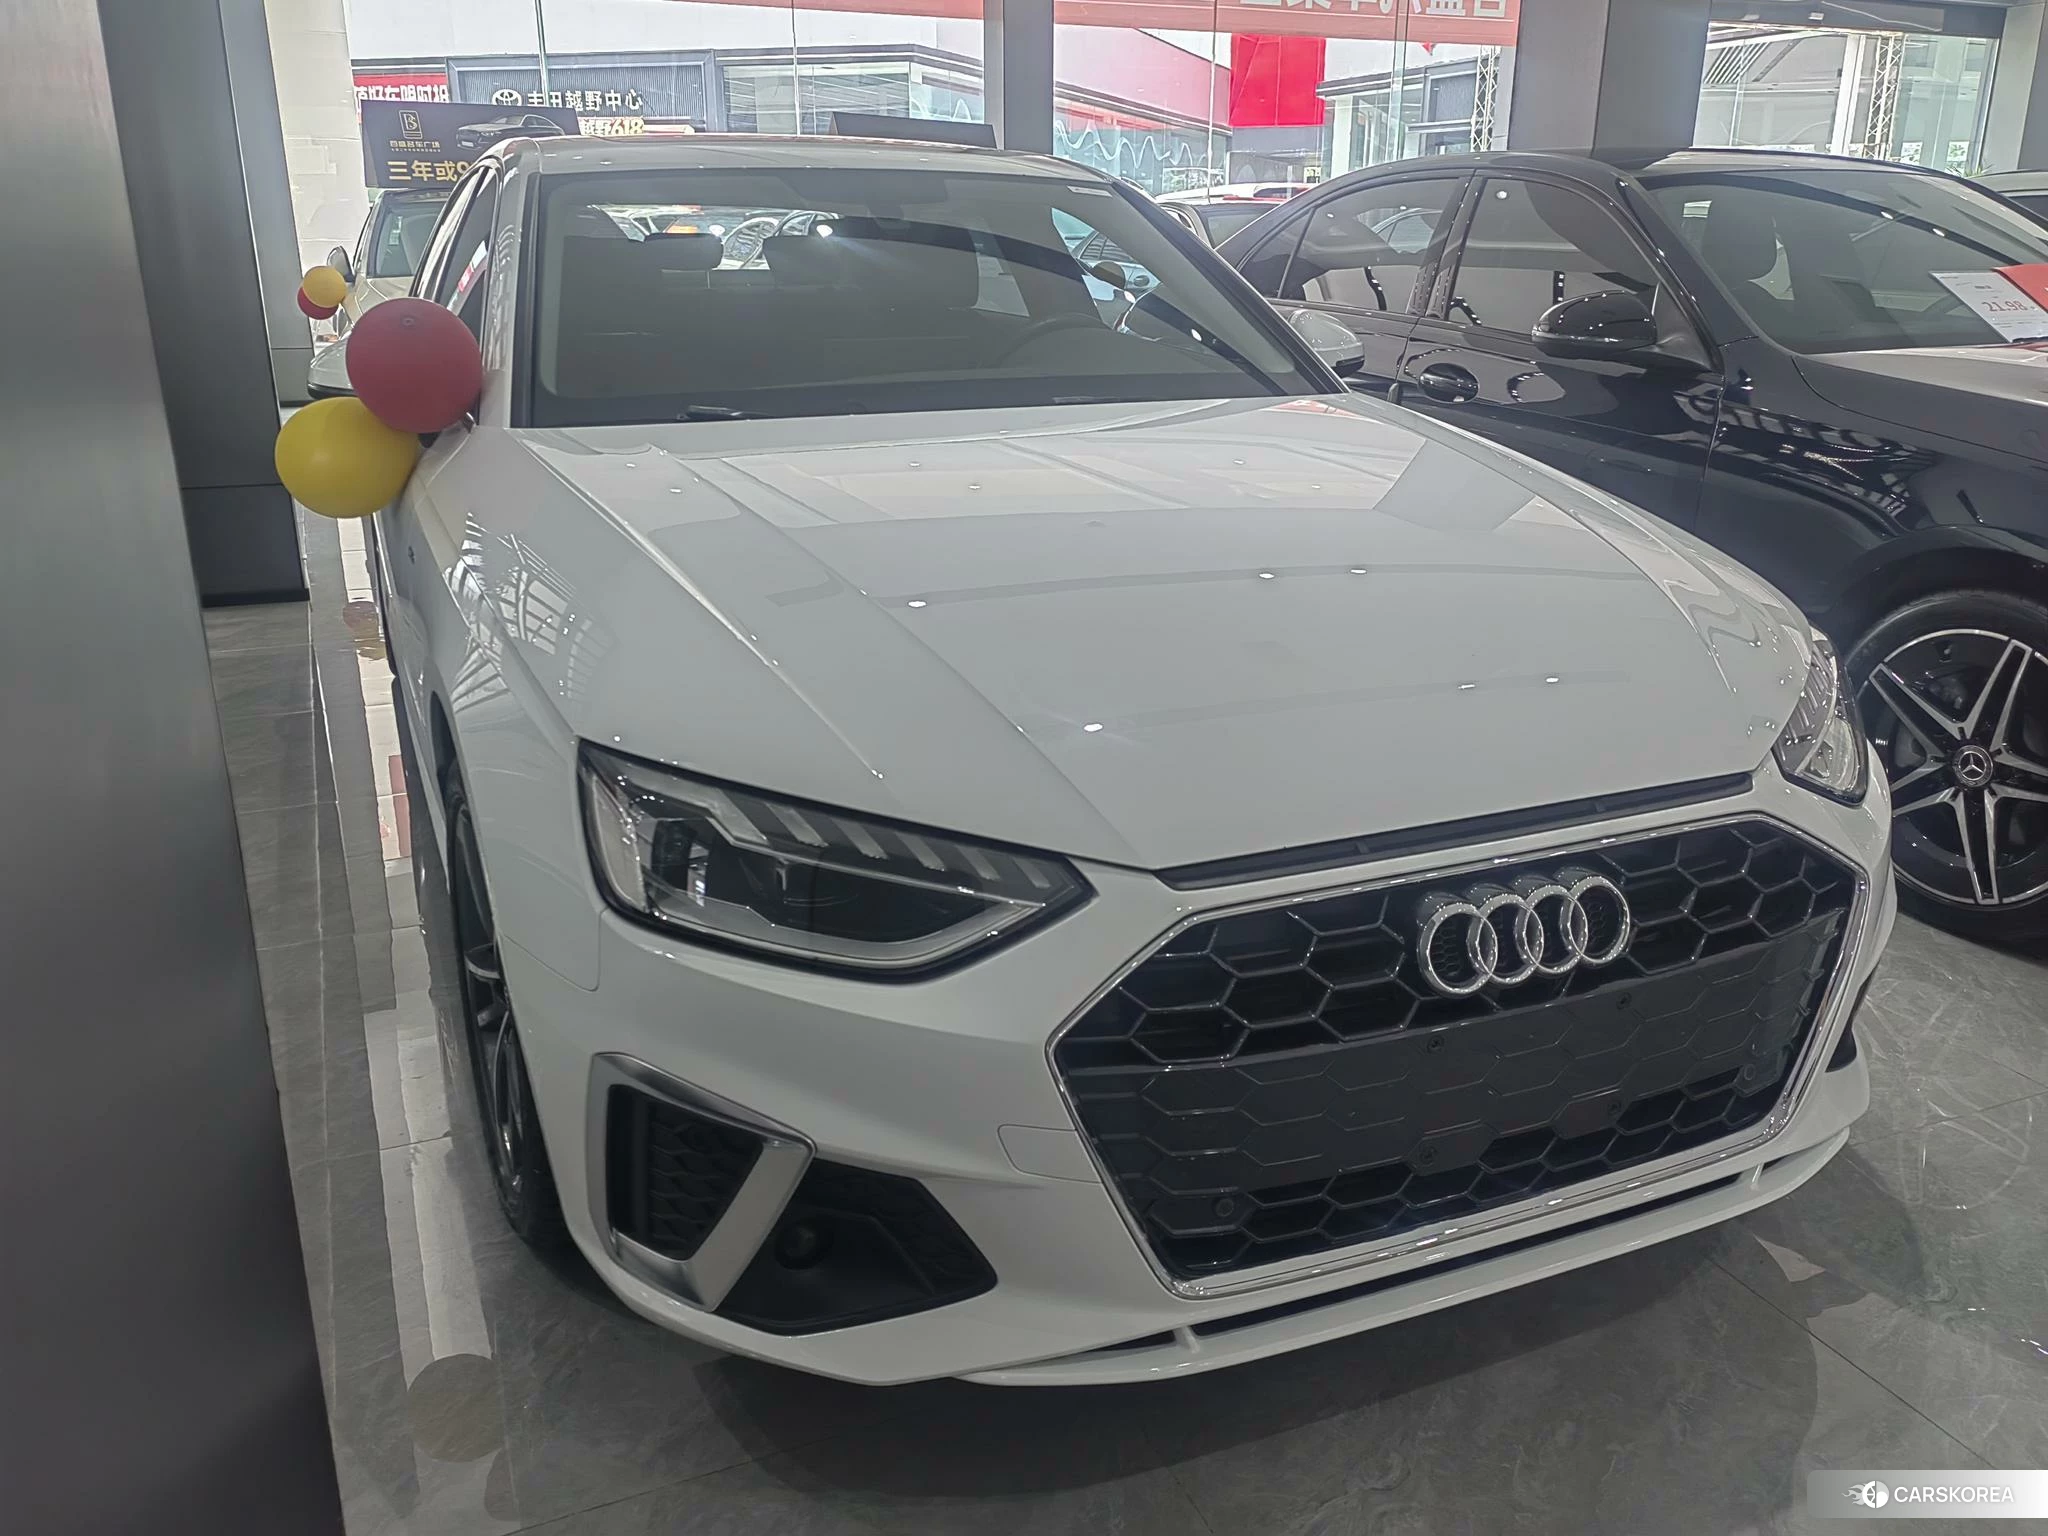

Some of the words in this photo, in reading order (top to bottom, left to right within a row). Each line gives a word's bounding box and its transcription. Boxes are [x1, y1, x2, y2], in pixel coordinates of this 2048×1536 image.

[527, 89, 643, 112] 丰田越野中心
